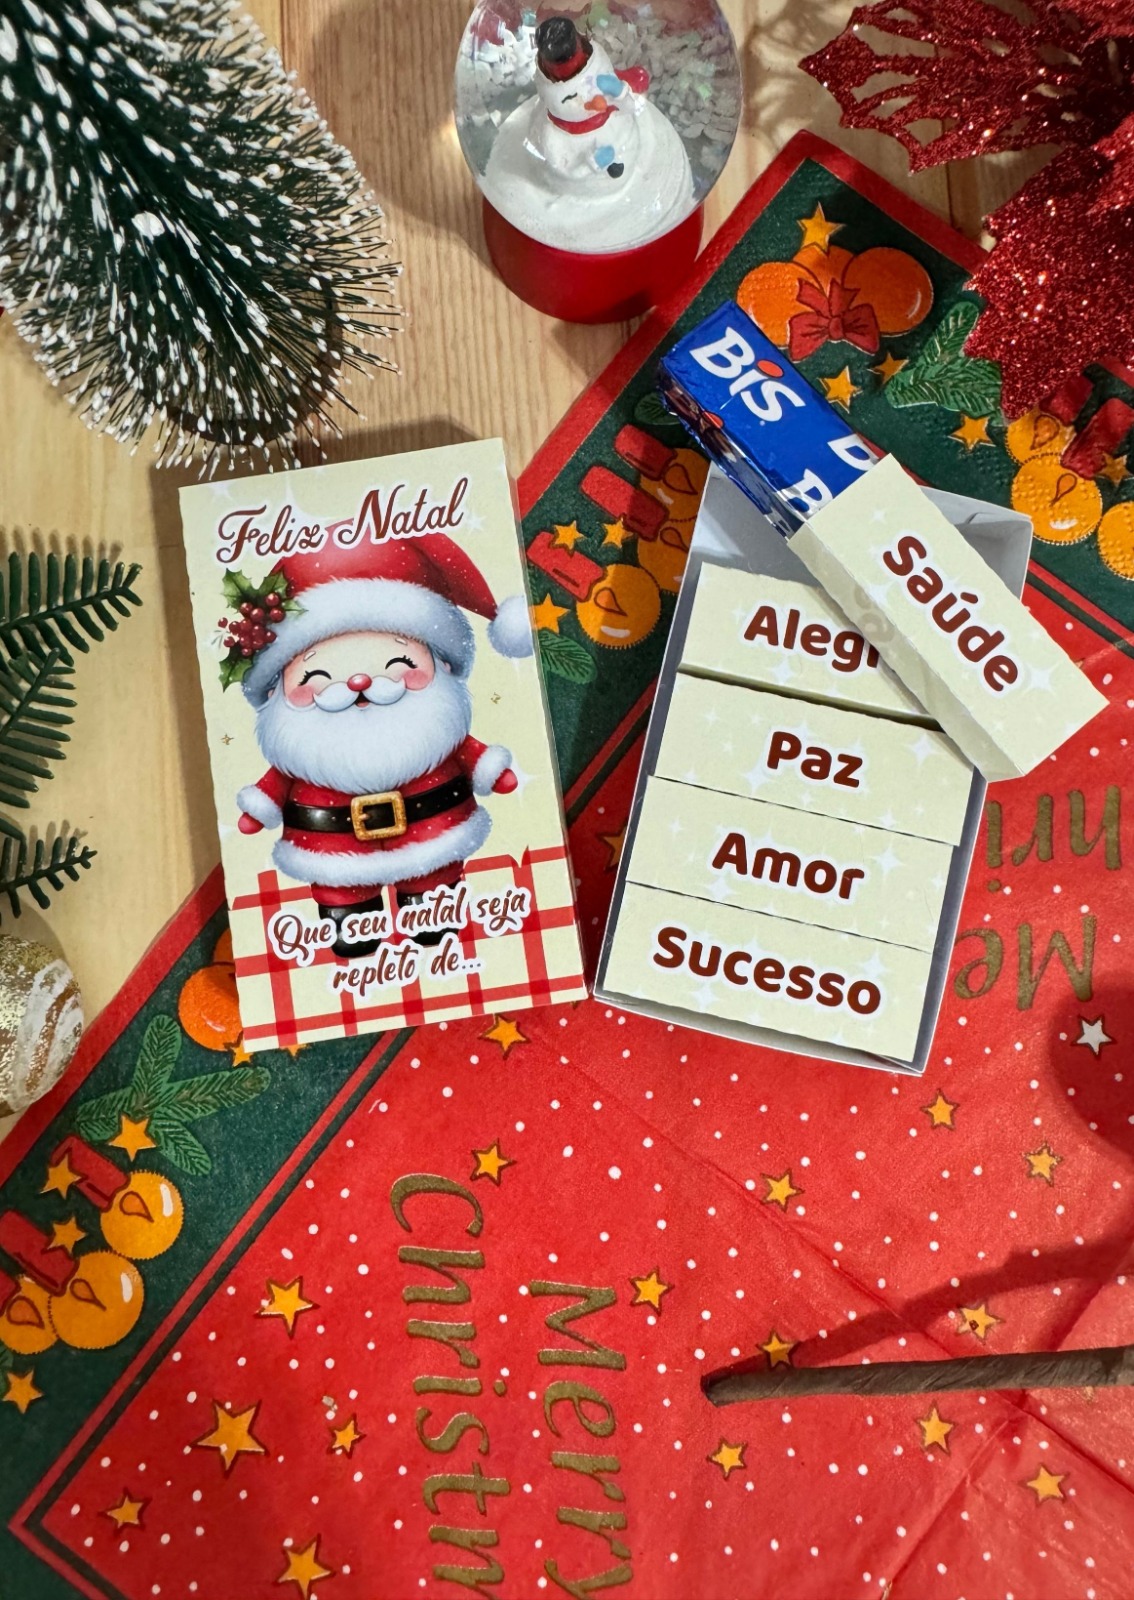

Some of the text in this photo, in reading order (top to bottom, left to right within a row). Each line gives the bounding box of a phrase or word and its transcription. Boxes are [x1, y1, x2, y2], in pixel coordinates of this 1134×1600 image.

[216, 477, 468, 563] Feliz Natal
[882, 535, 1019, 692] Saúde
[767, 731, 863, 788] Paz
[711, 832, 865, 900] Amor
[273, 887, 526, 961] Que seu natal seja
[332, 938, 482, 997] repleto de...
[653, 926, 882, 1016] Sucesso
[529, 1280, 633, 1600] Merry
